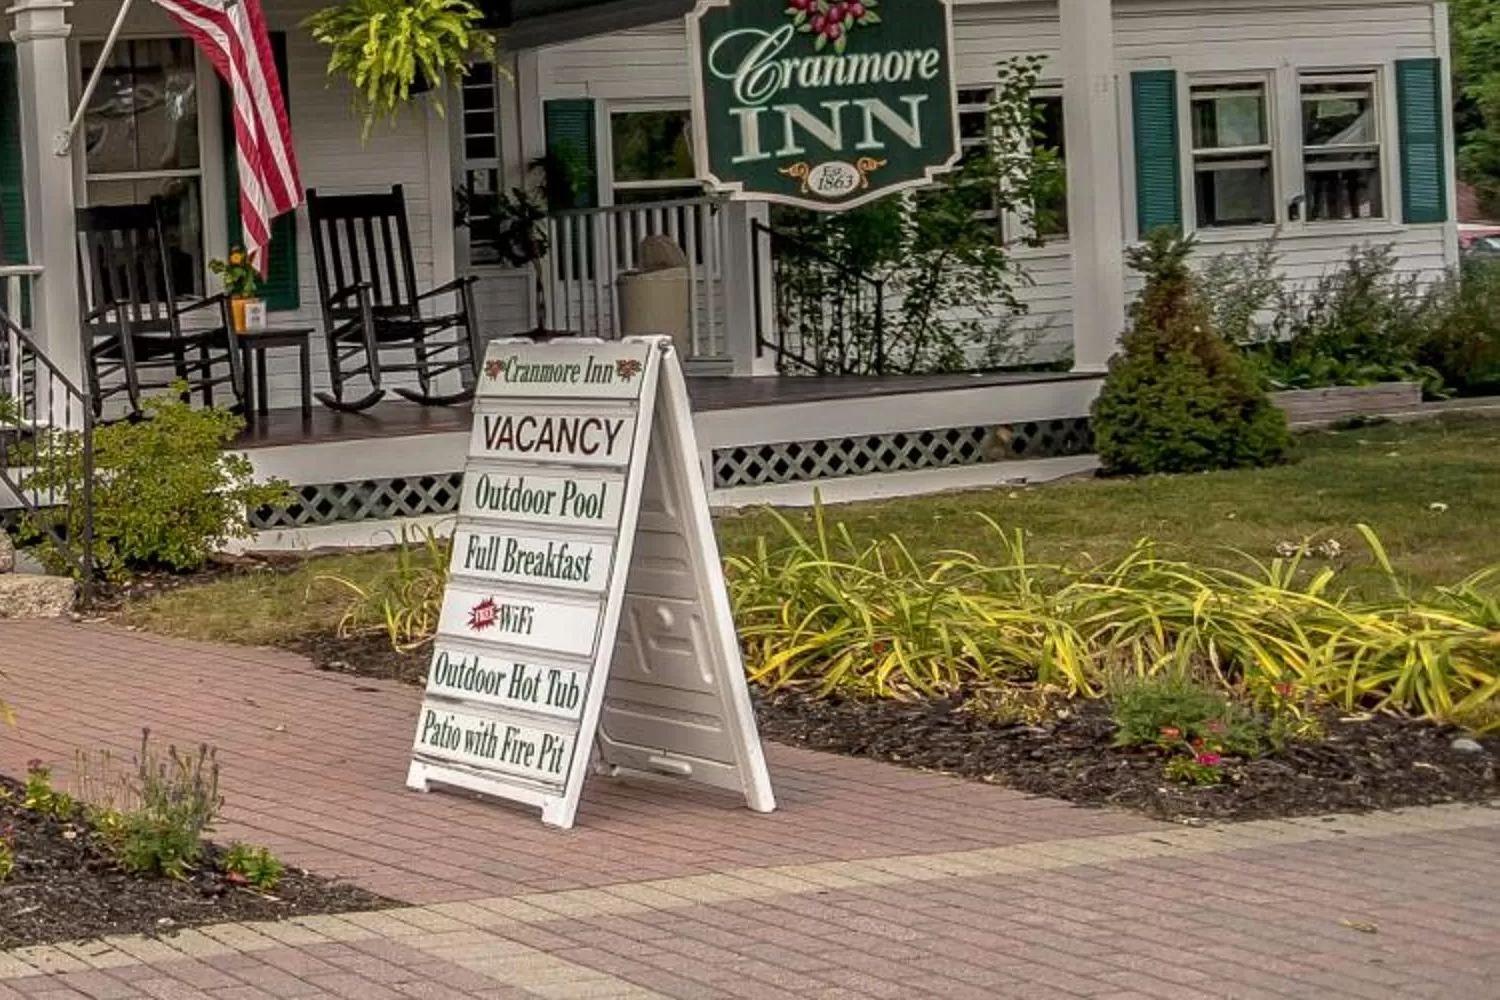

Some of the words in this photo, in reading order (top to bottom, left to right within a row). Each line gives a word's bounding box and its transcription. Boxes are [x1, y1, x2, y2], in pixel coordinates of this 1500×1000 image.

[708, 23, 940, 105] Cranmore
[728, 94, 929, 163] INN
[818, 174, 854, 191] 1863
[503, 355, 581, 383] Cranmore
[583, 355, 614, 383] Inn
[483, 415, 624, 456] VACANCY
[475, 473, 557, 515] Outdoor
[559, 480, 607, 520] Pool
[464, 534, 500, 572] Full
[502, 537, 593, 581] Breakfast
[499, 603, 535, 635] WiFi
[434, 651, 506, 697] Outdoor
[508, 663, 542, 702] Hot
[547, 669, 580, 711] Tub
[420, 710, 461, 750] Patio
[464, 721, 499, 758] with
[499, 725, 535, 767] Fire
[537, 732, 565, 775] Pit
